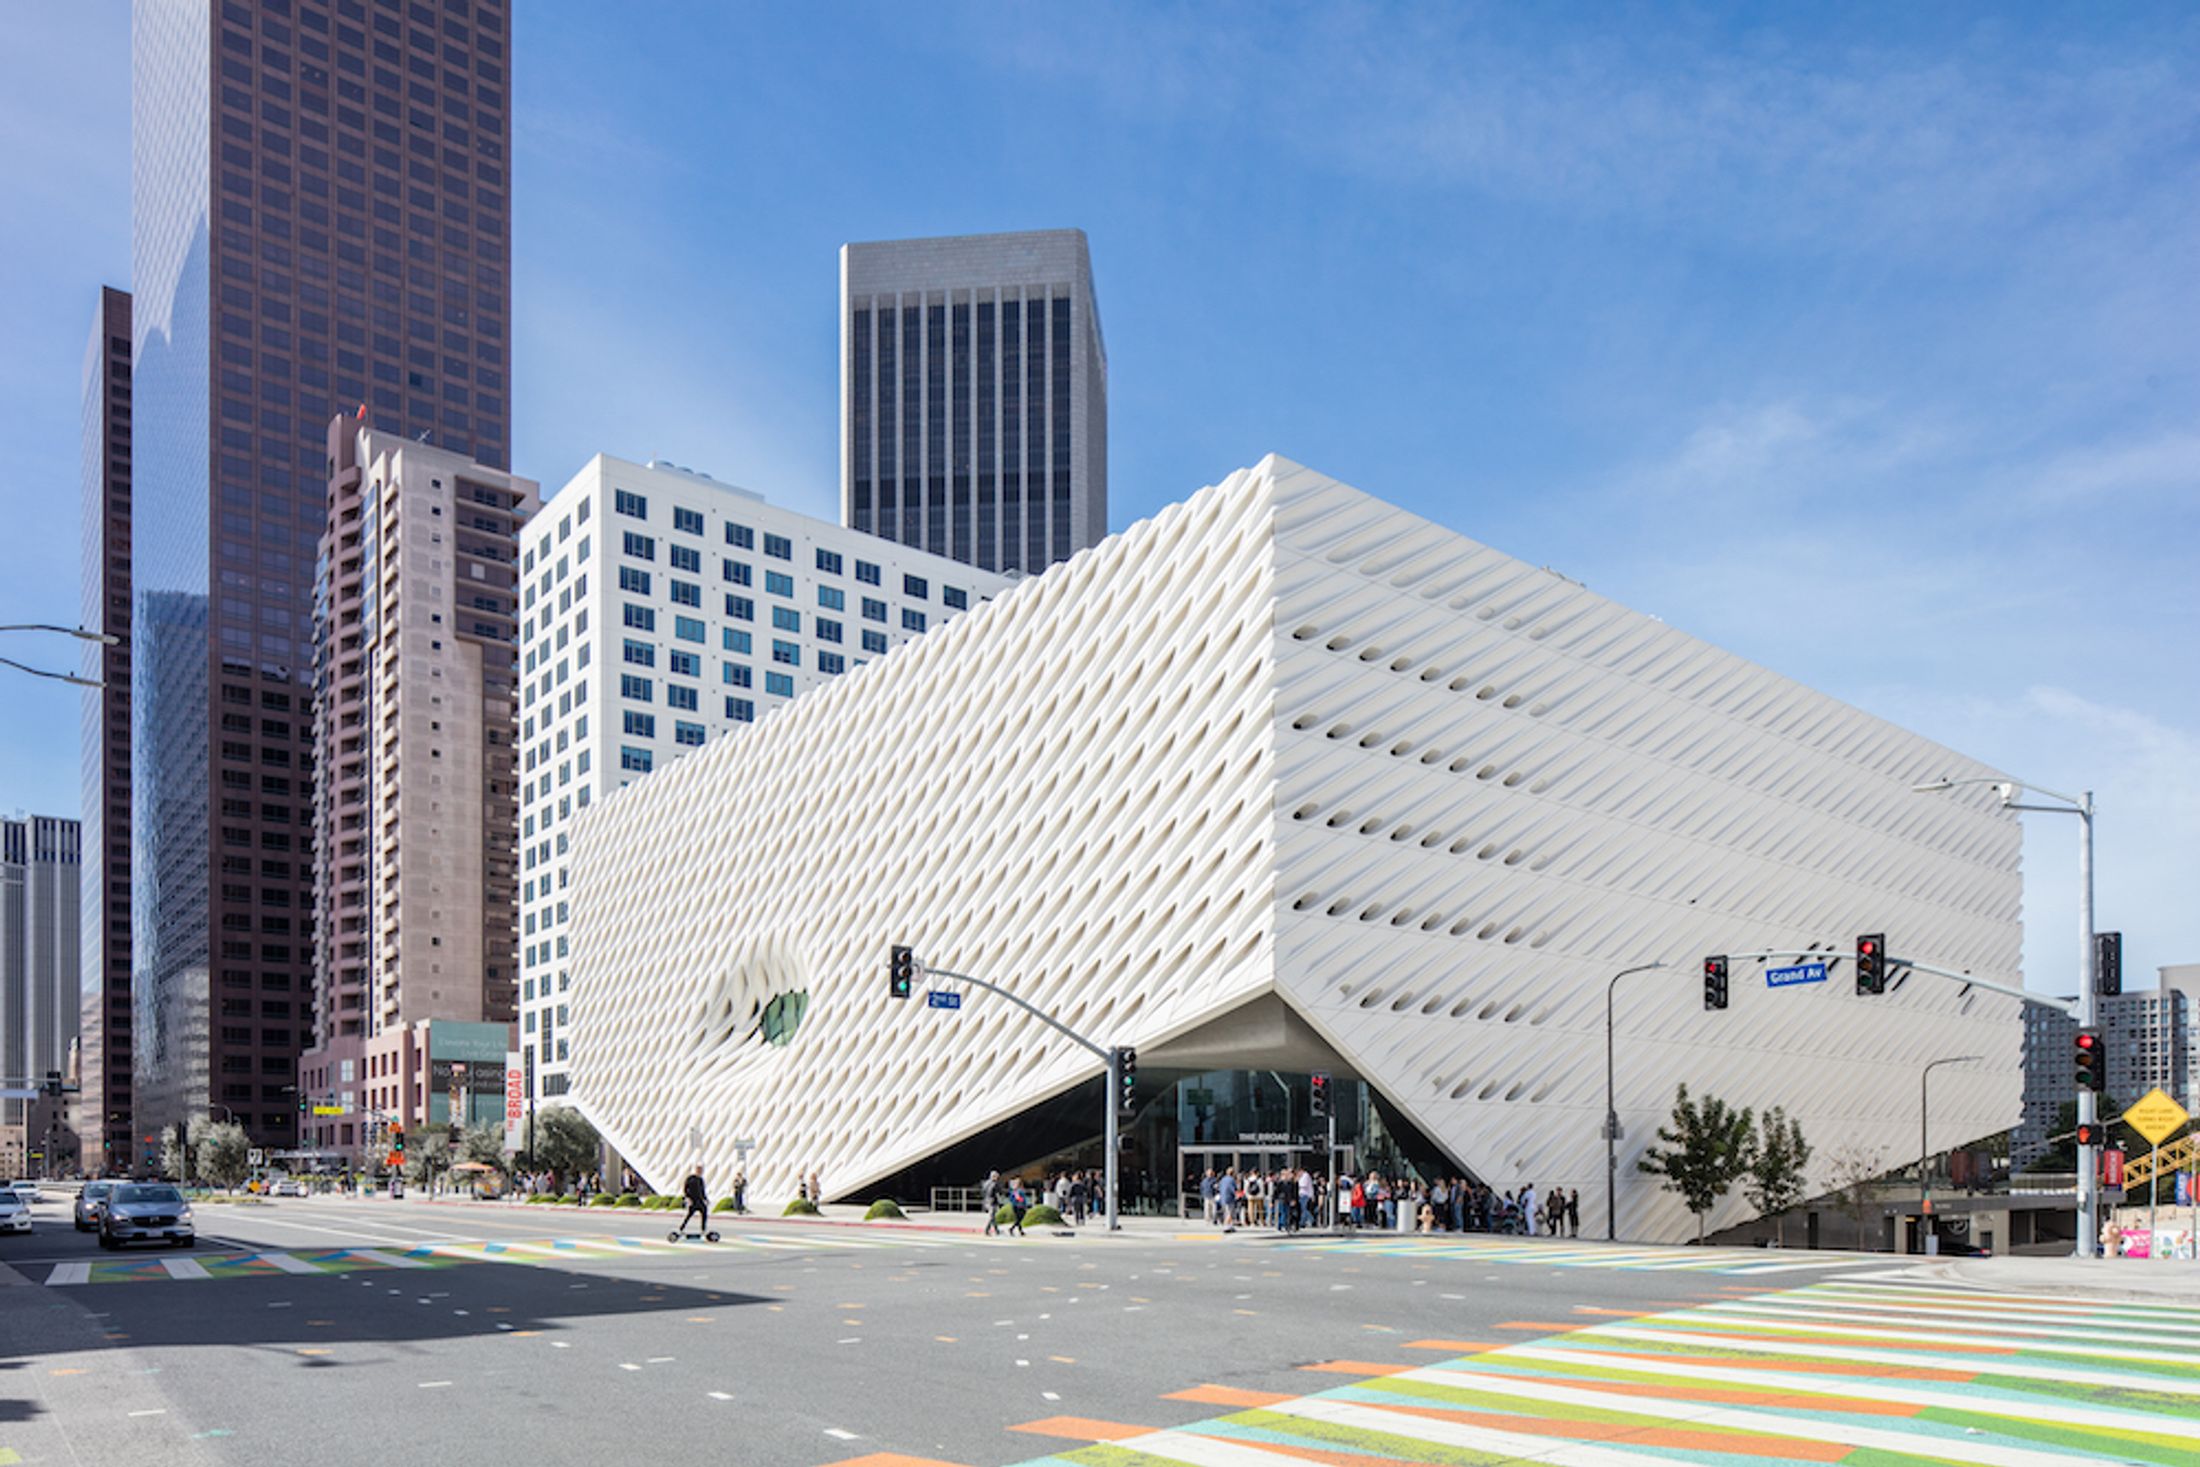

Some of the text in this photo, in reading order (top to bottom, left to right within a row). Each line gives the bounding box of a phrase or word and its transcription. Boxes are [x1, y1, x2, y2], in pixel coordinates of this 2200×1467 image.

[1770, 967, 1822, 983] Grand Av
[508, 1070, 522, 1118] BROAD
